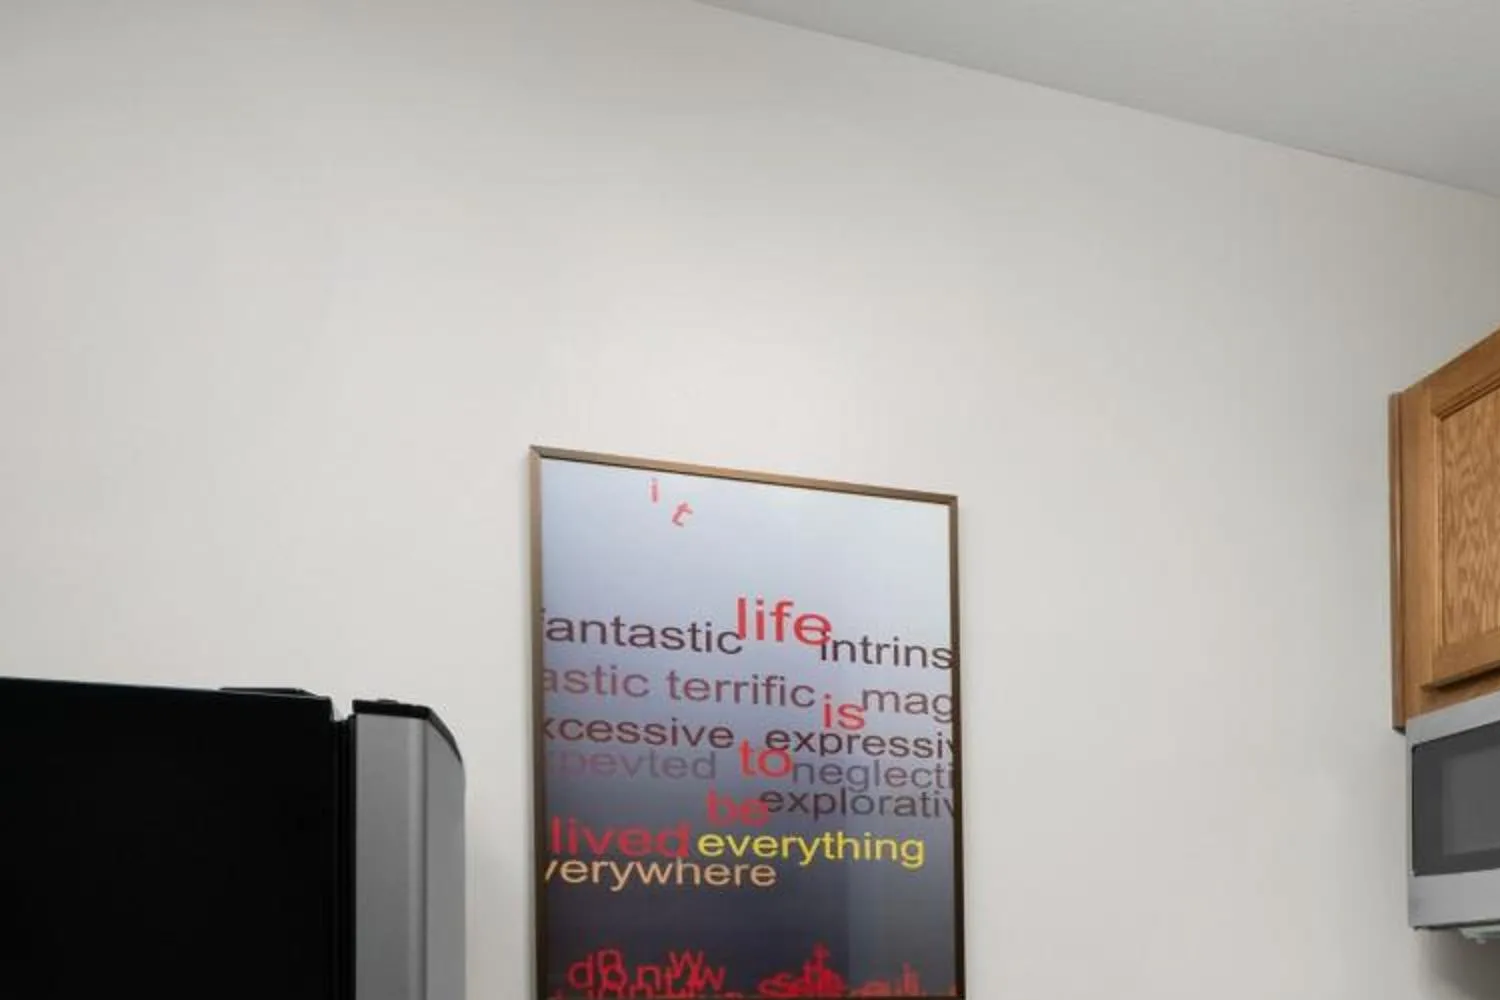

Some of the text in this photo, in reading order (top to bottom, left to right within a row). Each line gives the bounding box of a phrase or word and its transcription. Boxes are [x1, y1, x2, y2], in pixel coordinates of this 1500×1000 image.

[543, 606, 744, 655] antastic
[737, 597, 832, 646] life
[666, 670, 816, 708] terrific
[823, 693, 865, 730] is
[739, 740, 792, 778] to
[706, 789, 769, 827] be
[552, 817, 925, 870] lived everything
